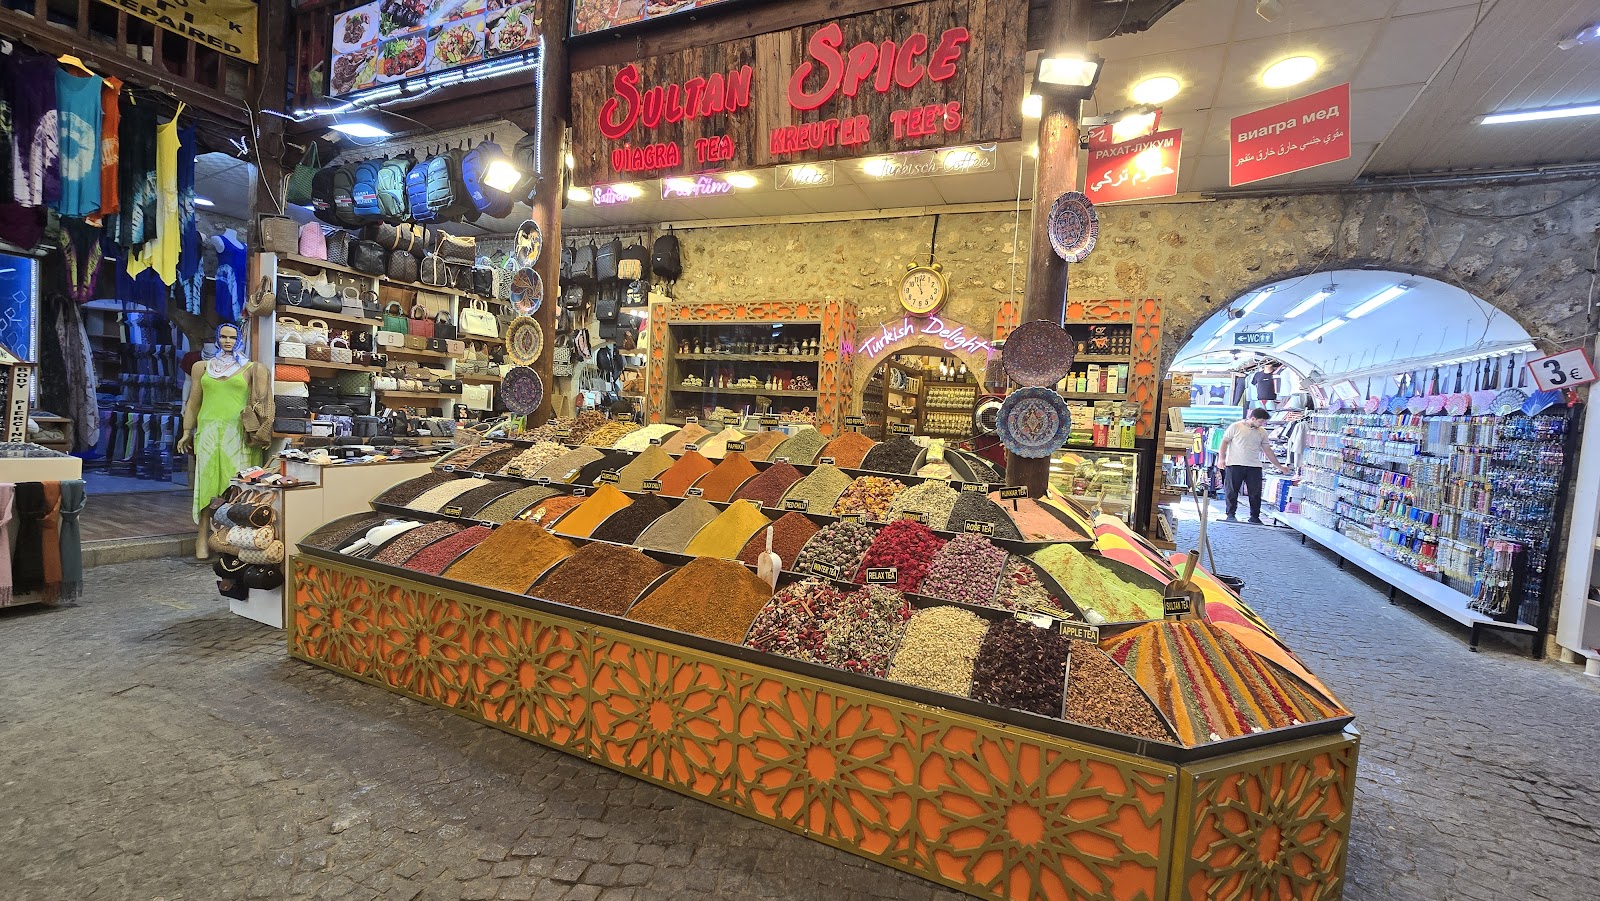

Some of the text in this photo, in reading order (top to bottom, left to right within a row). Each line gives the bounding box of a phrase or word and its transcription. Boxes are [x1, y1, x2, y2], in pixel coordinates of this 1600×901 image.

[107, 0, 242, 54] EPAIRED
[598, 23, 969, 140] SULTAN SPICE
[1238, 104, 1340, 143] виагра мед
[769, 114, 870, 154] KREUTER
[694, 135, 734, 162] TEA
[858, 315, 989, 358] Turkish Delight
[1247, 333, 1260, 343] WC
[17, 367, 28, 388] BODY
[1543, 359, 1567, 386] 3
[963, 483, 987, 493] GREEN TEA
[1018, 488, 1027, 496] TEA
[966, 522, 992, 533] ROSE TEA
[813, 563, 837, 577] WINTER TEA
[868, 571, 896, 580] RELAX TEA
[1166, 600, 1190, 611] SULTAN TEA
[1062, 626, 1097, 640] APPLE TEA
